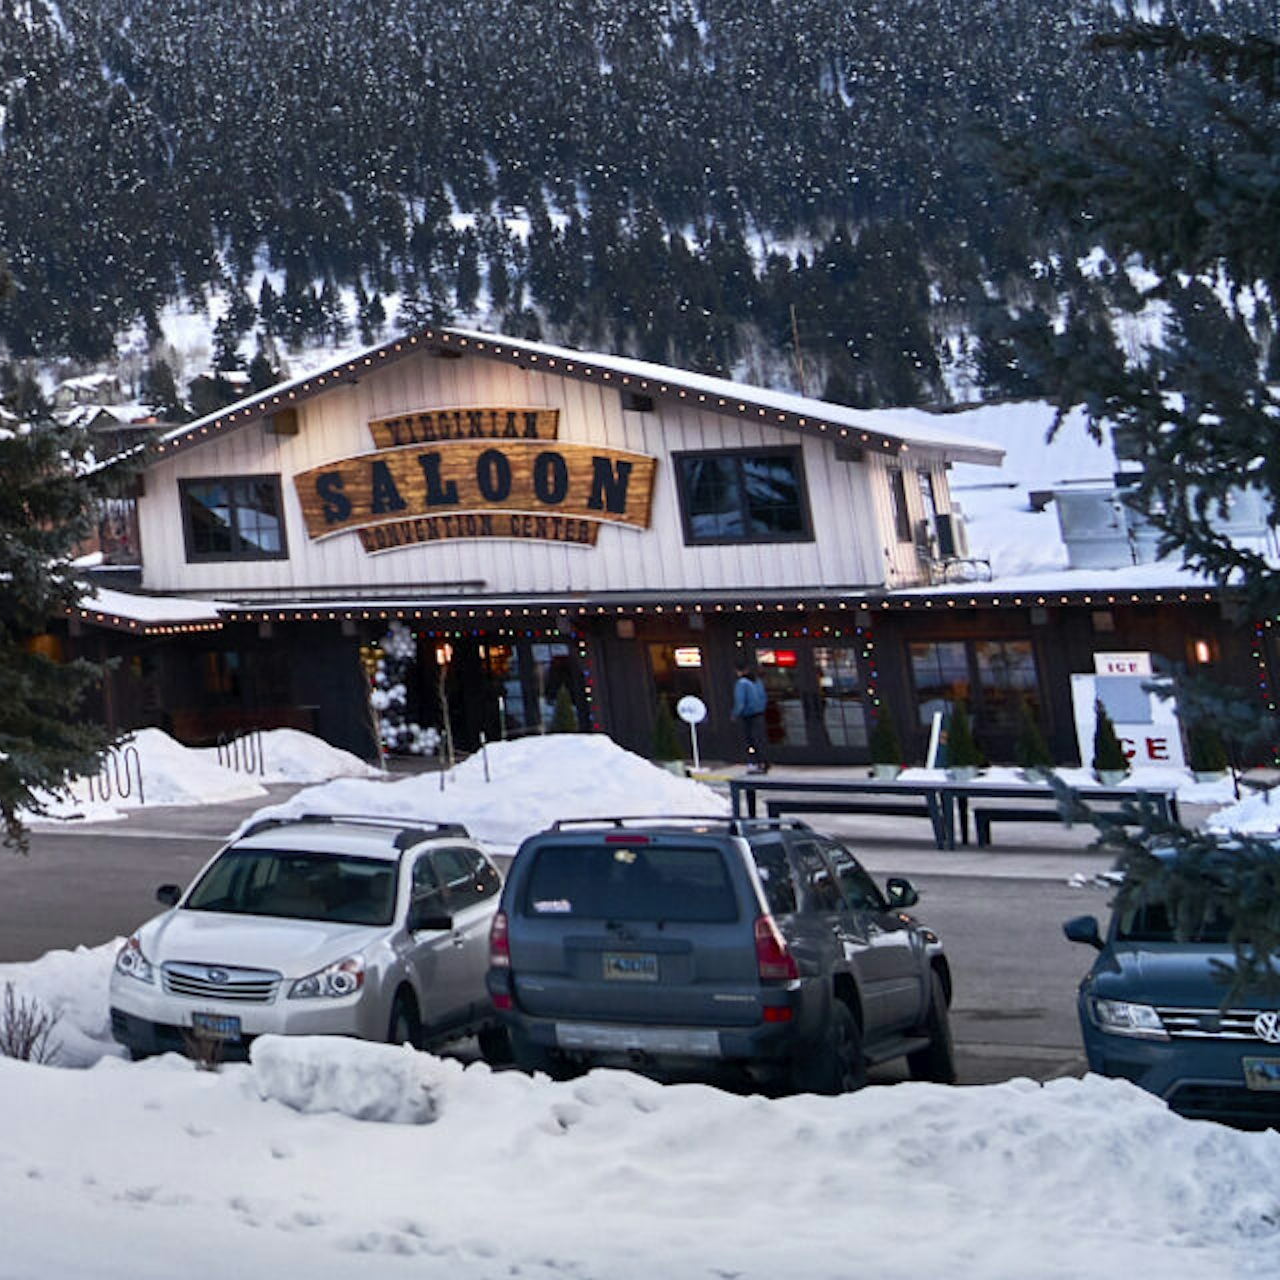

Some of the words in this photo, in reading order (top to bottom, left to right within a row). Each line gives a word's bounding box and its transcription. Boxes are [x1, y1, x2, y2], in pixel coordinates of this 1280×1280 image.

[384, 410, 539, 445] VIRGINIAN
[315, 448, 633, 522] SALOON
[361, 515, 494, 553] CONVENTION
[510, 515, 590, 545] CENTER
